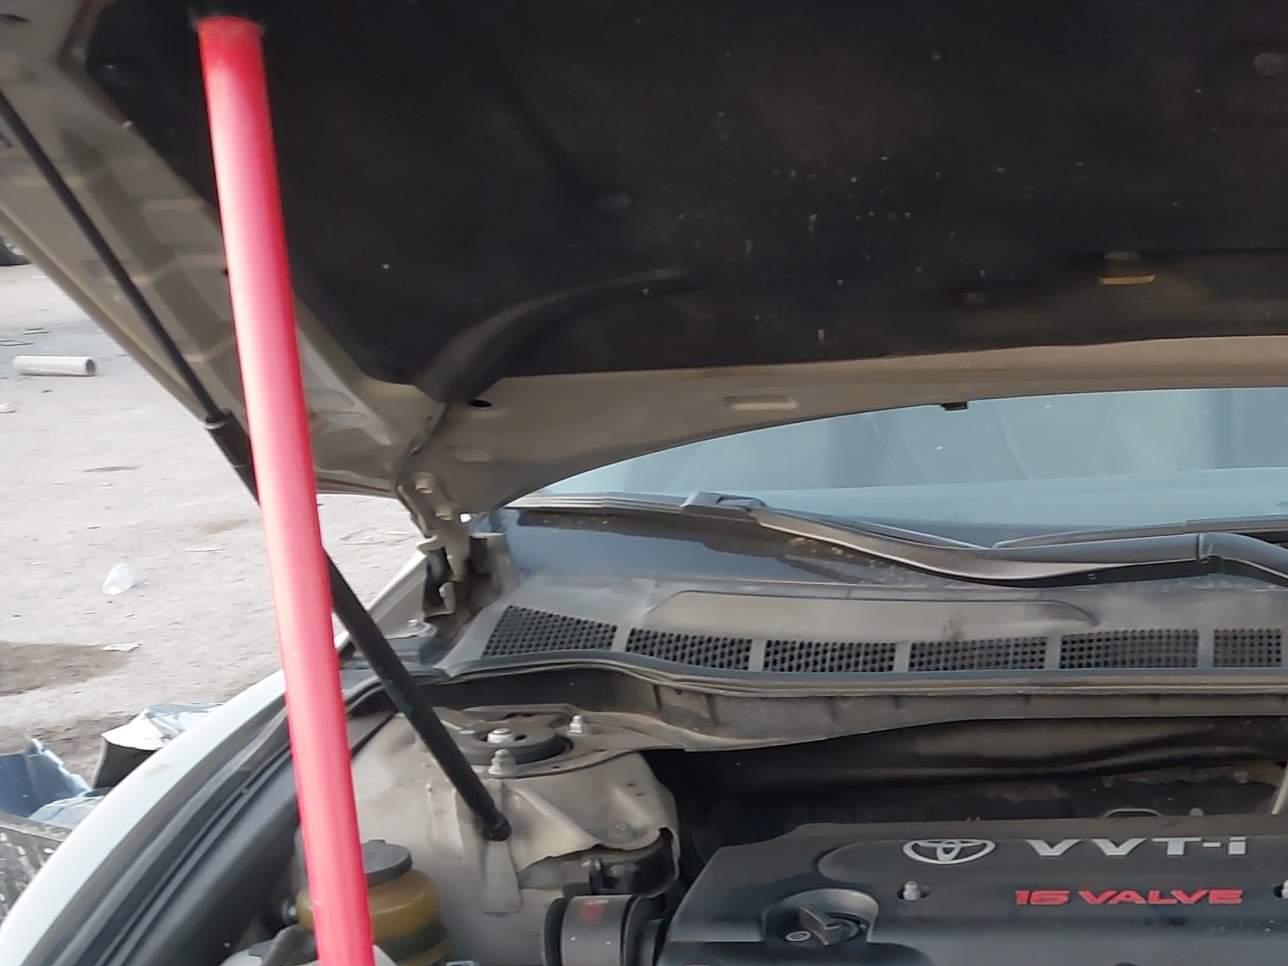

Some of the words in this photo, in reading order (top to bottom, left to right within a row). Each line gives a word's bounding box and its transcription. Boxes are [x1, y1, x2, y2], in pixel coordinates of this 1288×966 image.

[1025, 836, 1248, 857] VVT-i
[1014, 888, 1070, 906] 16
[1077, 888, 1243, 906] VALVE
